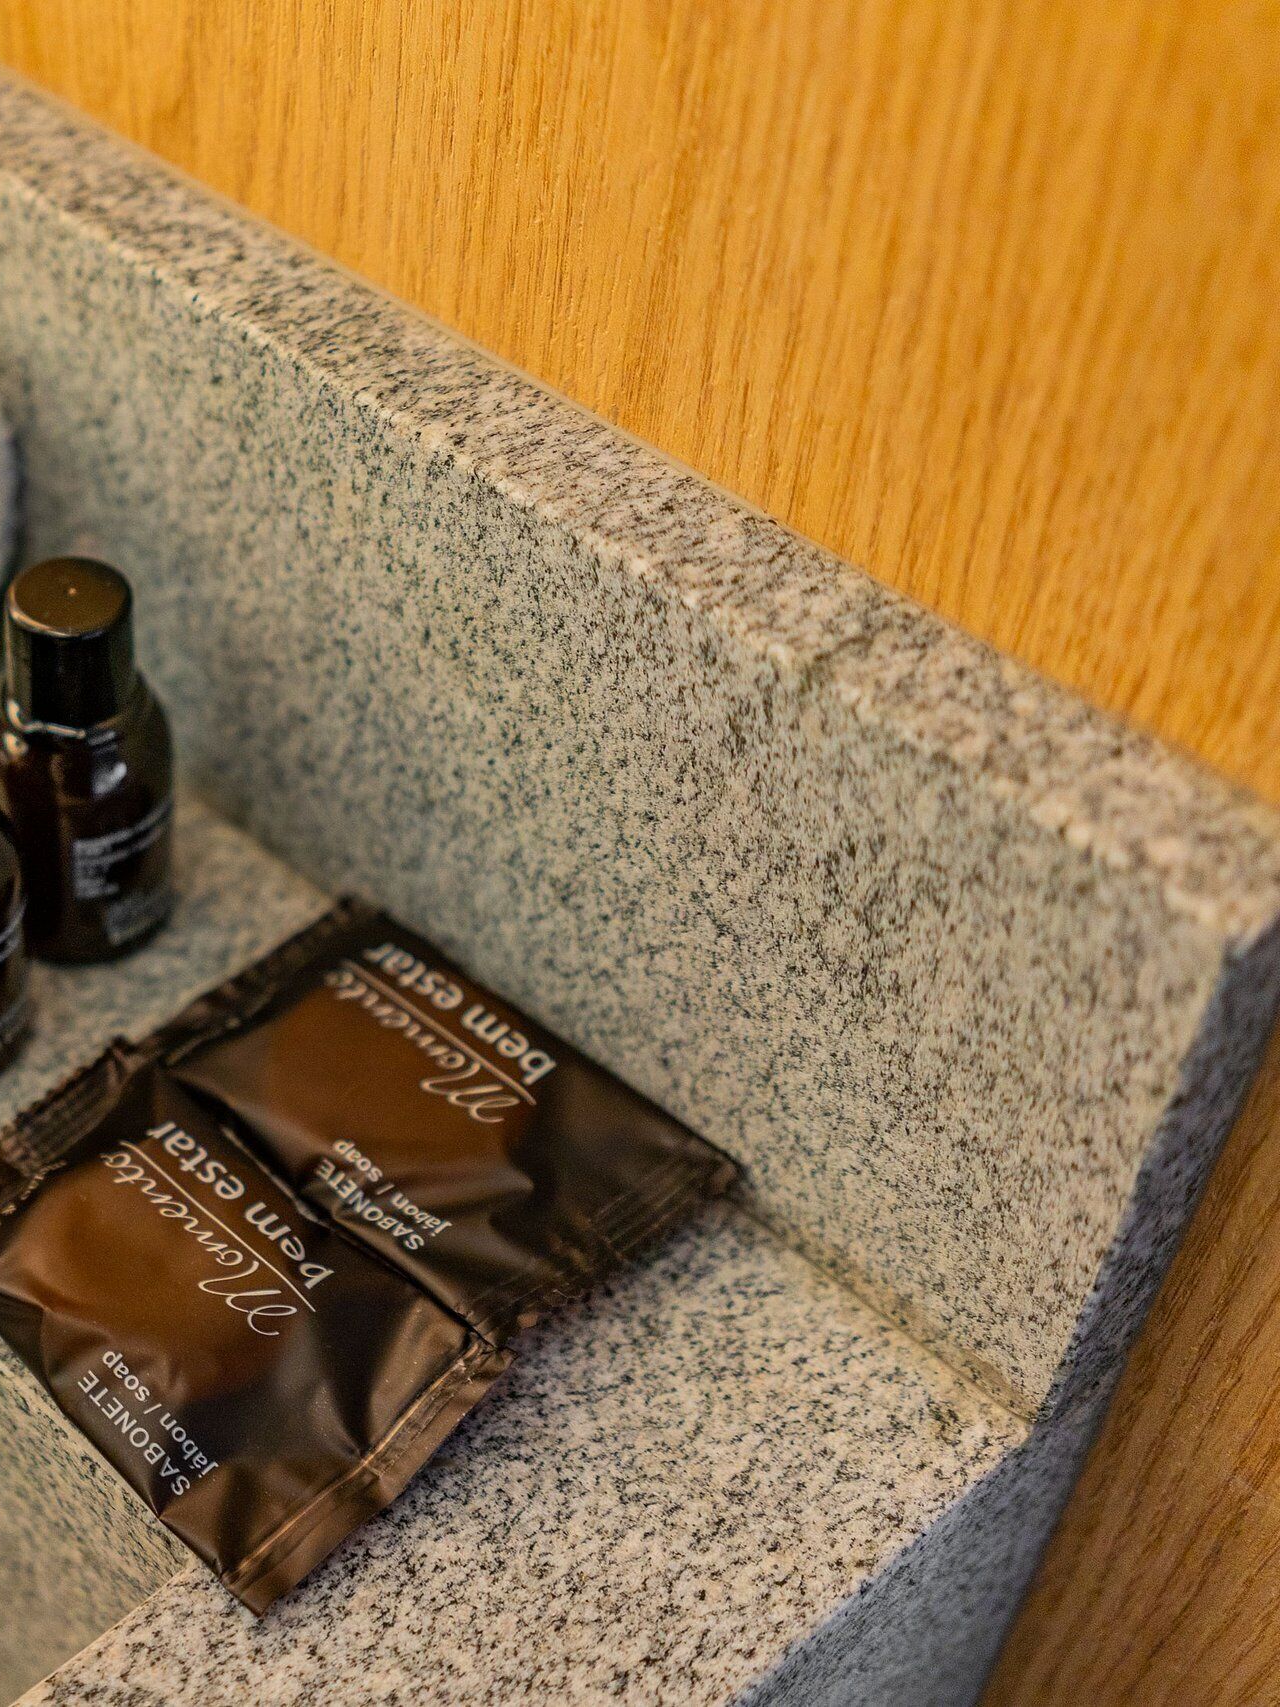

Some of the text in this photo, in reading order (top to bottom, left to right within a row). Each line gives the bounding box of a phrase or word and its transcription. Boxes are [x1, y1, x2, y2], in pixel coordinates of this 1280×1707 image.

[324, 970, 520, 1124] Momento
[363, 943, 557, 1086] bem estar
[146, 1121, 245, 1200] estar
[315, 1158, 426, 1250] SABONETE
[332, 1138, 383, 1182] soap
[375, 1183, 395, 1196] /
[100, 1152, 299, 1337] Momento
[243, 1201, 336, 1290] bem
[102, 1350, 151, 1402] soap
[143, 1403, 163, 1415] /
[77, 1369, 191, 1497] SABONETE
